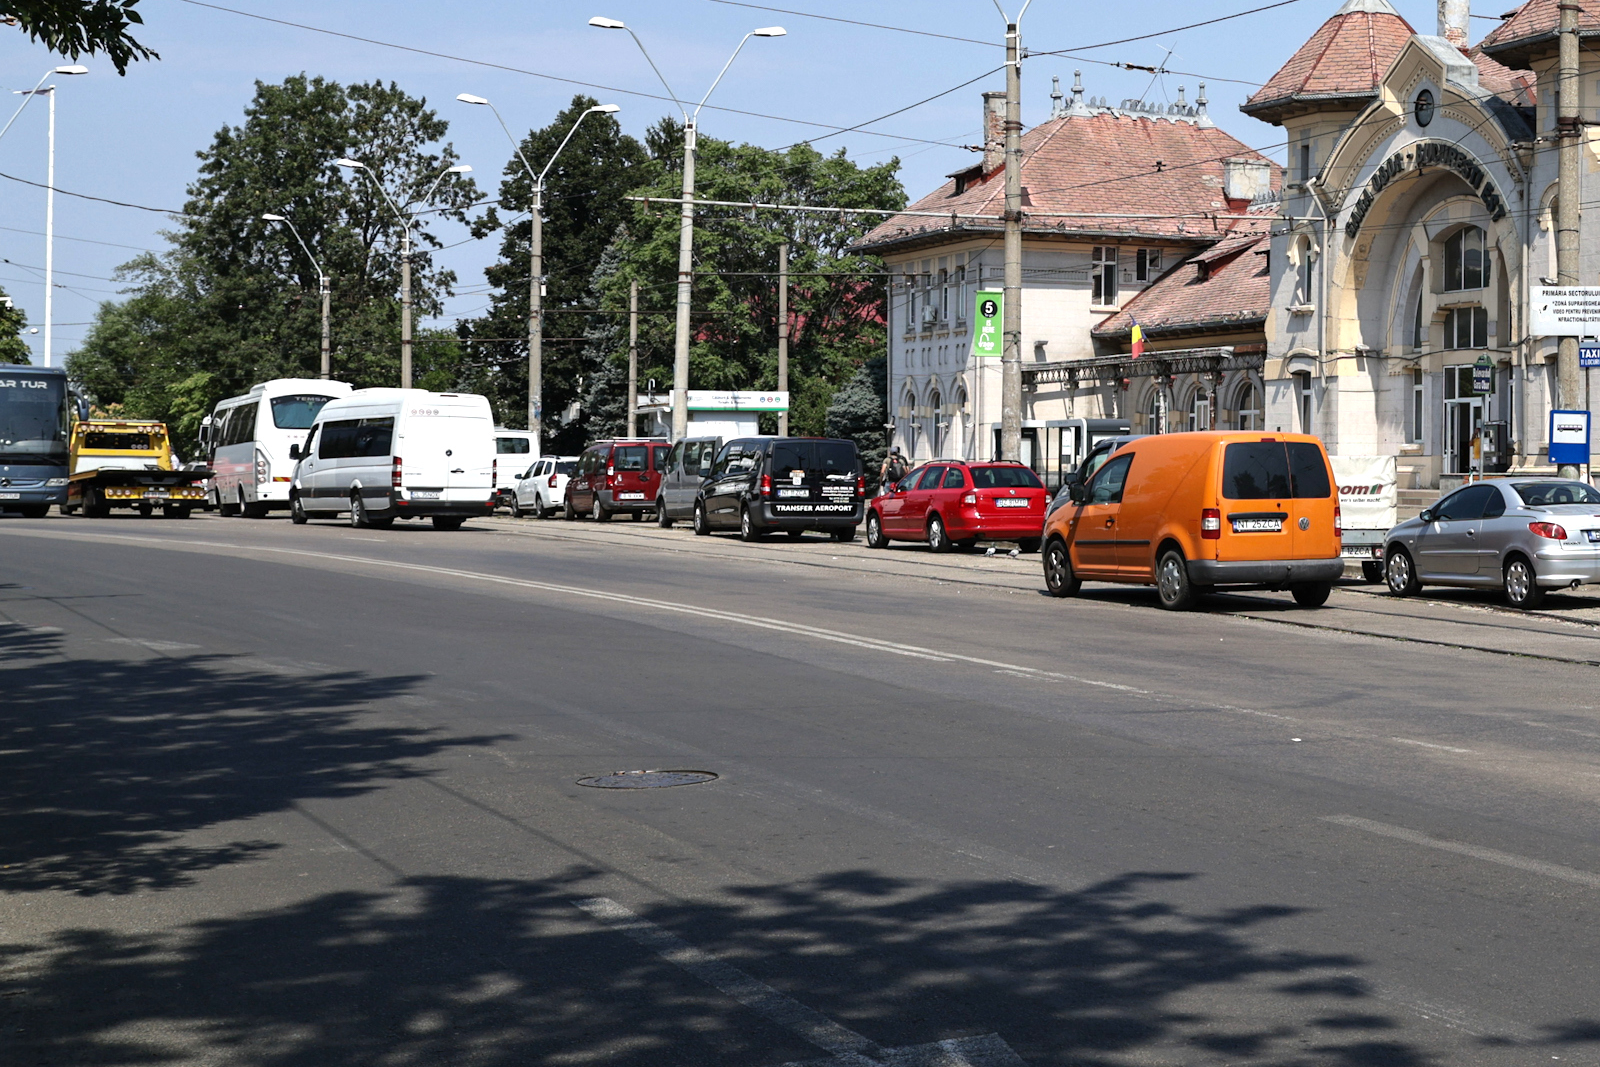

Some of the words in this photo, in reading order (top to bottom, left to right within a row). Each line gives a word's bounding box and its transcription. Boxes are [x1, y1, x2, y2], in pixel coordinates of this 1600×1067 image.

[985, 302, 994, 313] 5
[1580, 349, 1600, 358] TAXI
[20, 380, 47, 389] TUR
[1237, 519, 1248, 528] NT
